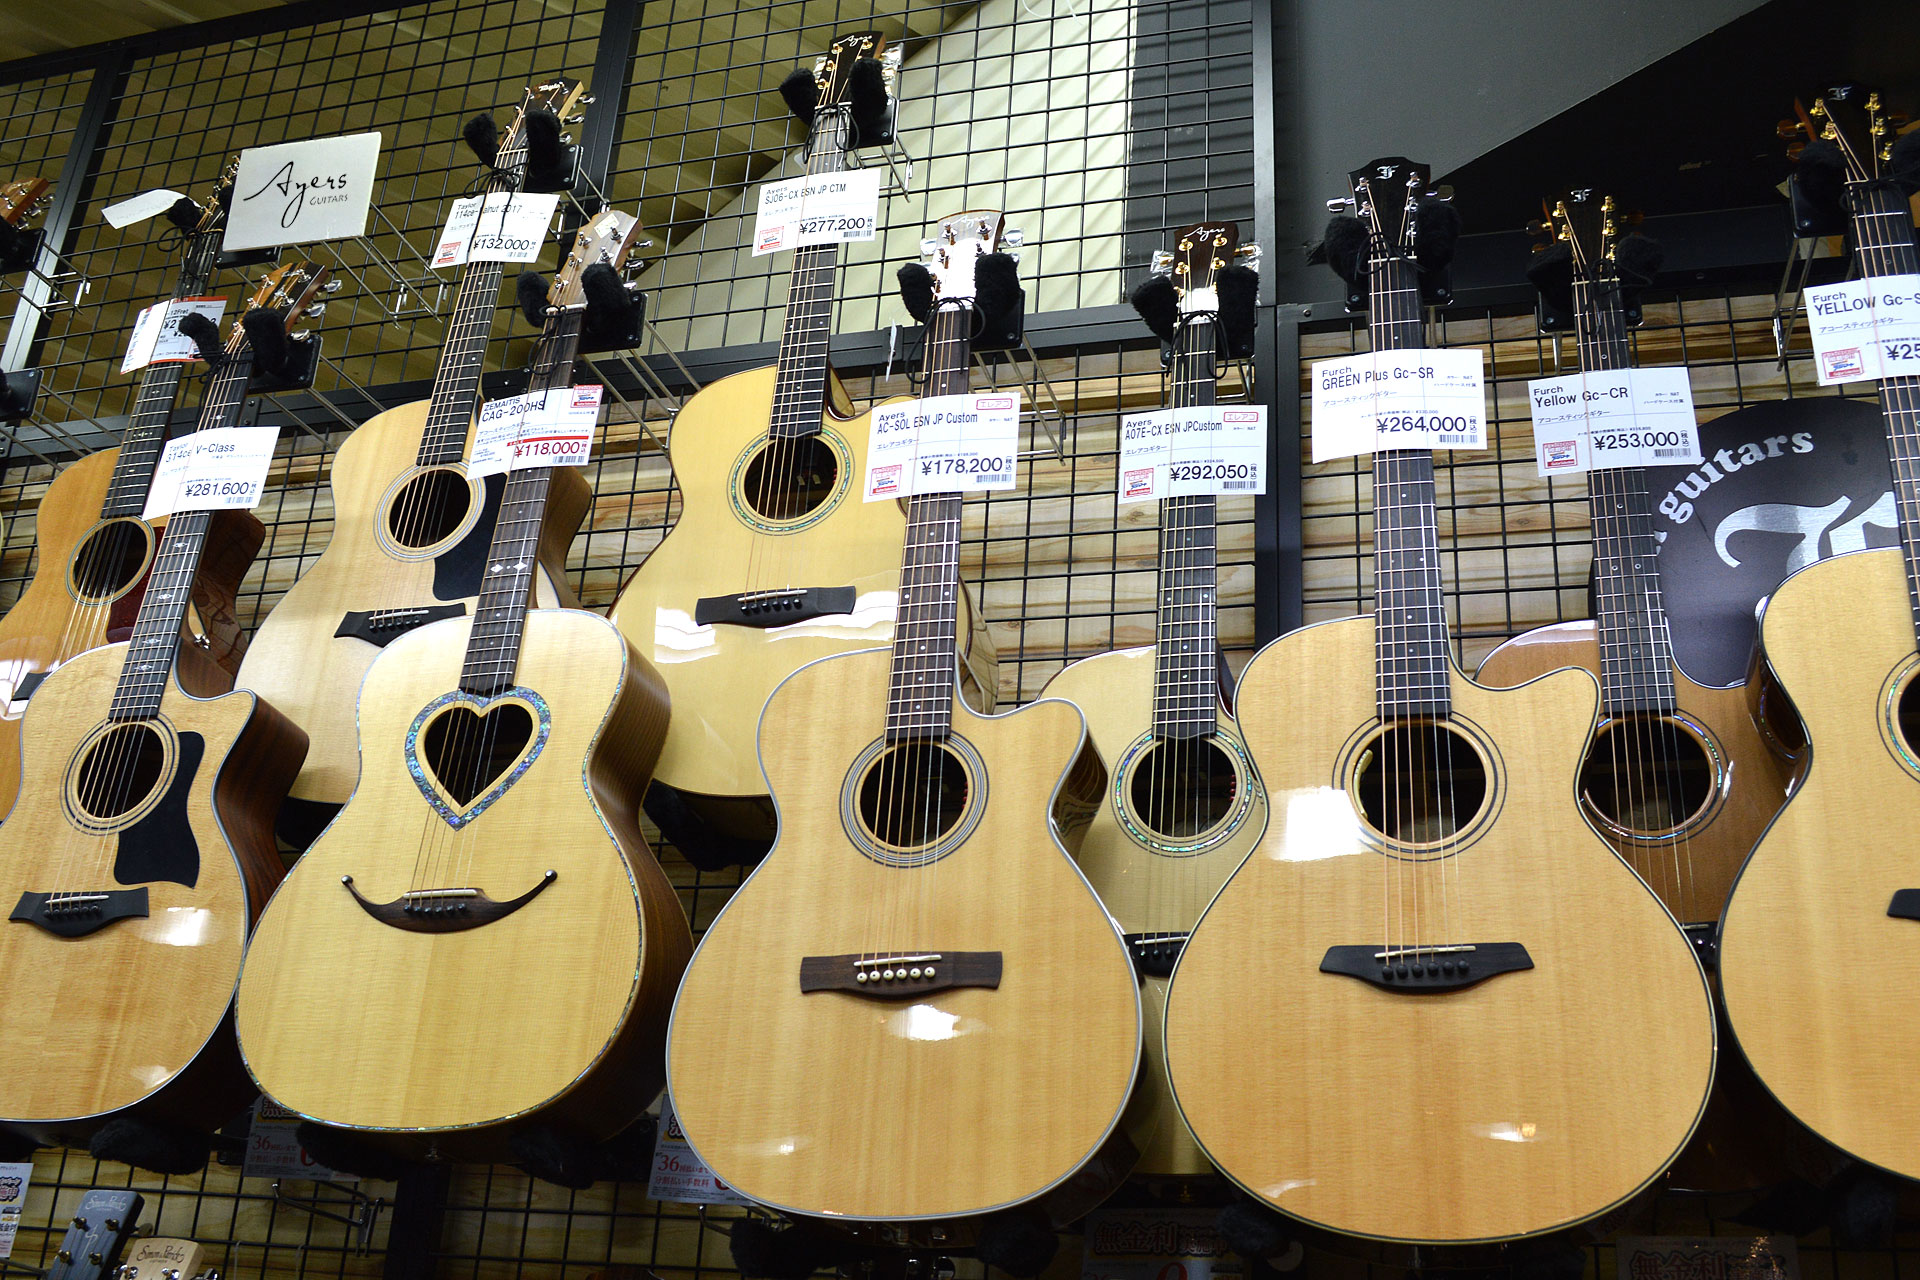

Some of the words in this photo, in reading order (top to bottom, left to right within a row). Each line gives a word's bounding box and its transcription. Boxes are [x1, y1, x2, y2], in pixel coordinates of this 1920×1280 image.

[243, 161, 347, 228] Ayers
[766, 186, 788, 195] Ayers
[801, 186, 815, 197] ESN
[818, 185, 827, 194] JP
[829, 183, 846, 193] CTM
[309, 194, 348, 206] GUITARS
[457, 202, 477, 210] Taylor
[455, 205, 499, 219] 114ce-alnut
[501, 204, 523, 213] 2017
[799, 217, 865, 234] ¥277,200
[473, 238, 530, 250] ¥132,000
[1812, 291, 1847, 303] Furch
[1814, 296, 1876, 316] YELLOW
[1818, 317, 1903, 334] アコースティックギター
[1321, 366, 1352, 378] Furch
[1322, 372, 1361, 391] GREEN
[1365, 370, 1389, 383] Plus
[1393, 367, 1434, 380] Gc-SR
[1533, 385, 1564, 396] Furch
[1535, 393, 1576, 408] Yellow
[1582, 387, 1629, 402] Gc-CR
[481, 400, 545, 422] CAG-200HS
[484, 397, 521, 411] ZEMAITIS
[877, 419, 911, 435] AC-SOL
[913, 415, 930, 428] ESN
[932, 413, 944, 425] JP
[946, 412, 978, 424] Custom
[878, 412, 906, 422] Ayers
[1125, 419, 1153, 429] Ayers
[1376, 416, 1467, 433] ¥264,000
[1537, 410, 1611, 424] アコースティックギター
[1125, 425, 1163, 440] A07E-CX
[1165, 422, 1181, 435] ESN
[196, 443, 236, 455] V-Class
[514, 442, 580, 457] ¥118,000
[1593, 431, 1679, 451] ¥253,000
[922, 457, 1003, 476] ¥178,200
[1170, 464, 1248, 481] ¥292,050
[1658, 432, 1815, 524] guitars
[185, 481, 250, 498] ¥281,600
[1095, 1220, 1178, 1255] 無金利
